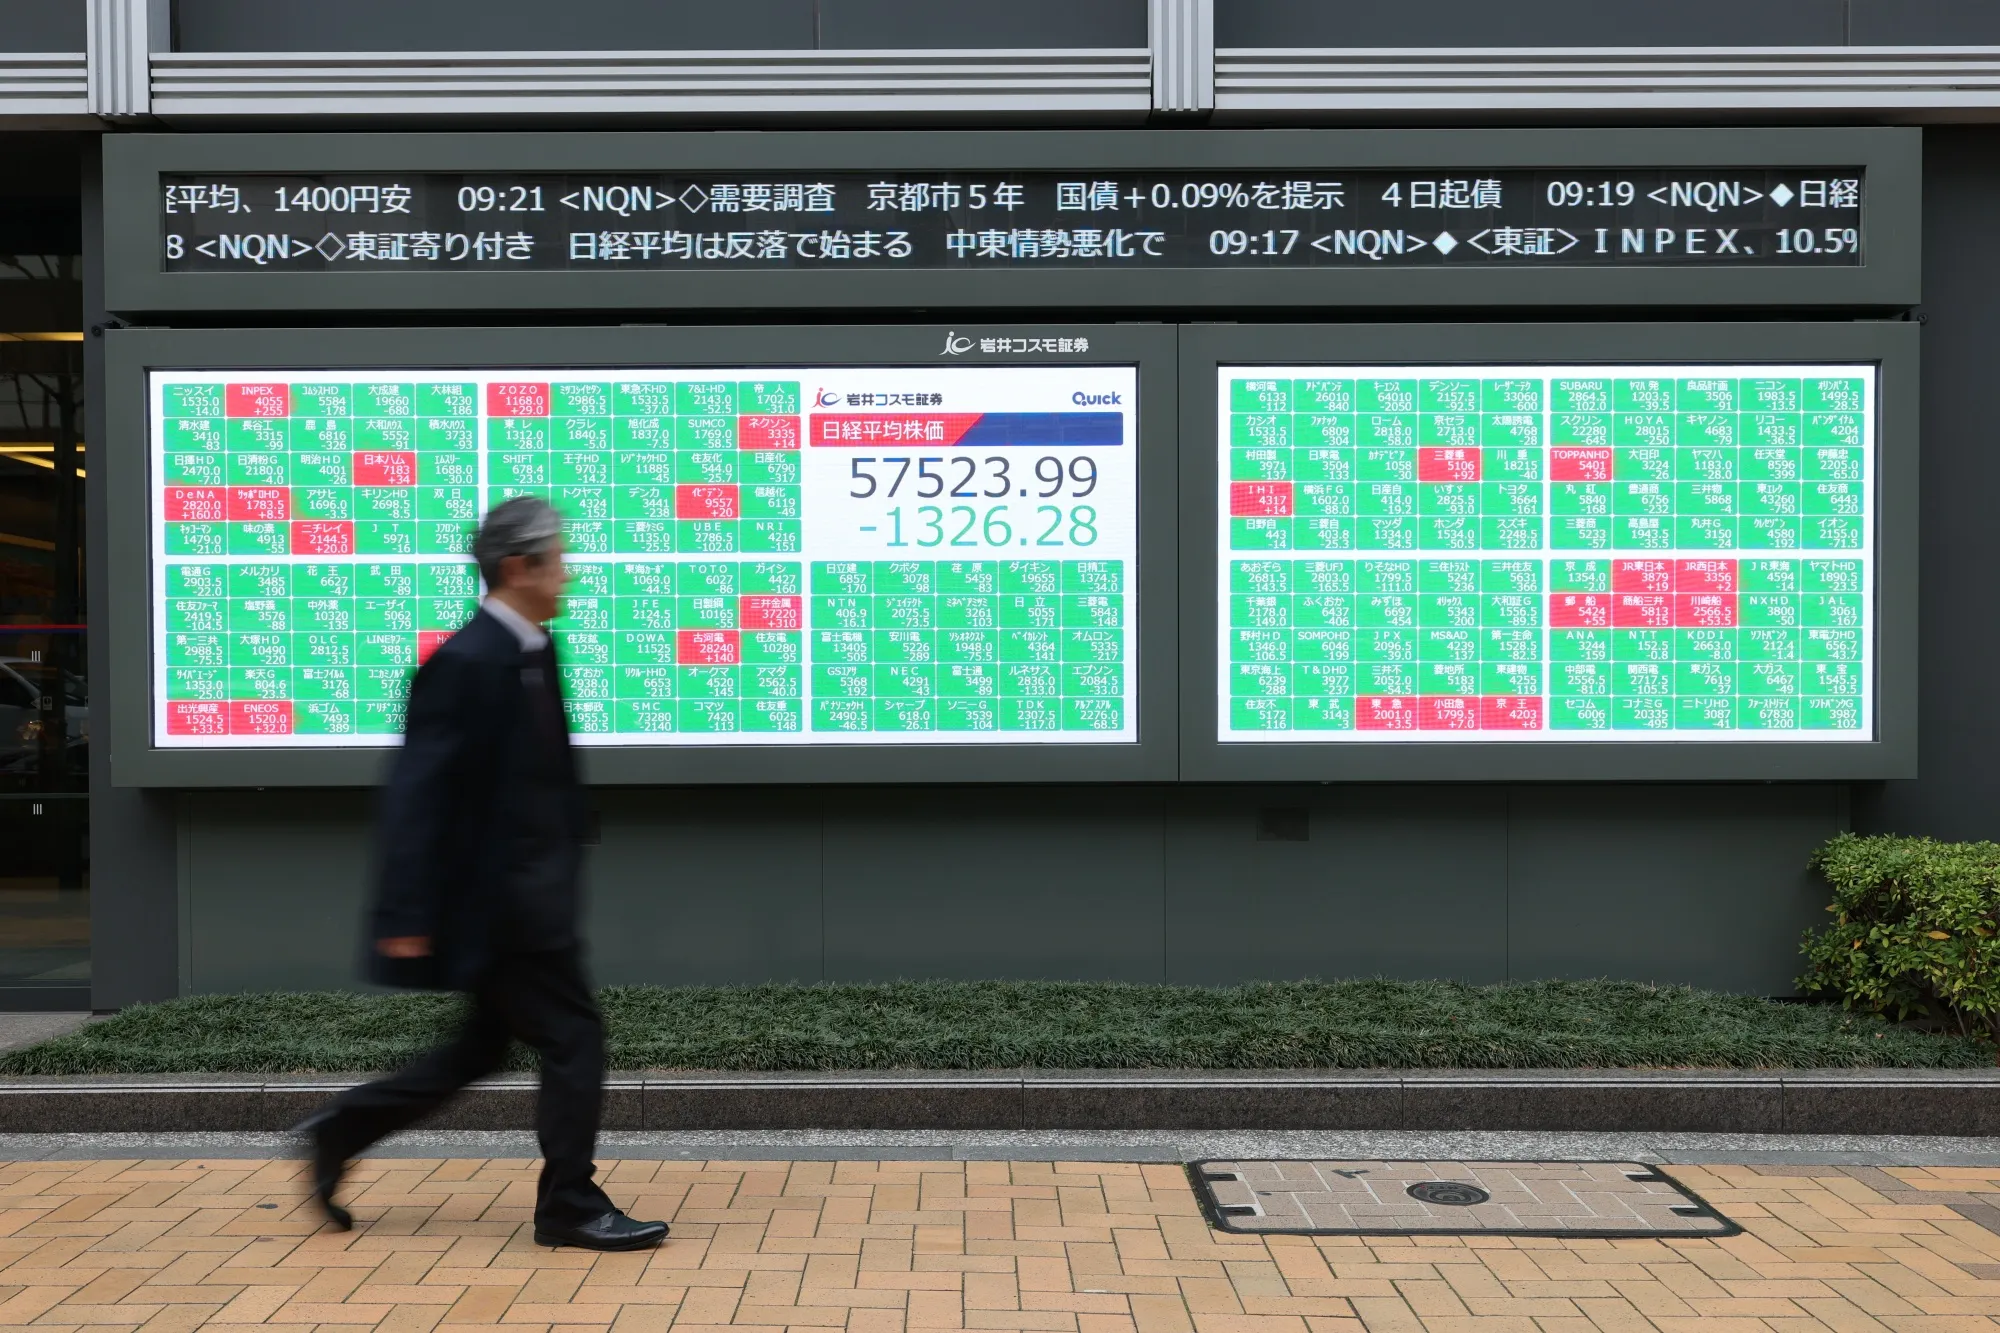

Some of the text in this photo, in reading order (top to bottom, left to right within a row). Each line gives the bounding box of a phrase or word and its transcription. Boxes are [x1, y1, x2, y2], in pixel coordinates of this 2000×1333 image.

[458, 187, 544, 211] 09:21
[867, 181, 1024, 211] 京都市5年
[1382, 179, 1501, 208] 4日起債
[1548, 182, 1634, 206] 09:19
[570, 230, 911, 260] 日経平均は反落で始まる
[947, 229, 1164, 257] 中東情勢悪化で
[1210, 230, 1298, 254] 09:17
[980, 336, 1089, 353] 岩井コスモ証券
[172, 386, 215, 396] ニッスイ
[241, 387, 274, 395] INPEX
[367, 385, 400, 396] 大成建
[430, 385, 463, 395] 大林組
[1428, 381, 1471, 391] デンソー
[1559, 382, 1603, 390] SUBARU
[1754, 381, 1787, 391] ニコン
[375, 396, 410, 405] 19660
[443, 396, 473, 405] 4230
[846, 393, 943, 406] 岩井コスモ証券
[1436, 392, 1475, 402] 2157.5
[1567, 391, 1607, 401] 2864.5
[1757, 391, 1796, 401] 1983.5
[181, 397, 220, 406] 1535.0
[254, 397, 284, 406] 4055
[1445, 402, 1476, 411] -92.5
[1568, 401, 1607, 411] -102.0
[1765, 401, 1796, 410] -13.5
[189, 406, 220, 416] -14.0
[253, 406, 283, 416] +255
[383, 406, 410, 415] -680
[446, 406, 473, 415] -186
[565, 419, 597, 429] クラレ
[627, 418, 660, 428] 旭化成
[687, 419, 726, 428] SUMCO
[748, 418, 791, 428] ネクソン
[1245, 415, 1277, 426] カシオ
[568, 430, 607, 440] 1840.5
[631, 429, 670, 439] 1837.0
[694, 429, 733, 439] 1769.0
[767, 429, 796, 438] 3335
[822, 420, 945, 441] 日経平均株価
[1248, 427, 1287, 436] 1533.5
[1704, 426, 1733, 435] 4683
[583, 440, 607, 449] -5.0
[646, 439, 670, 448] -7.5
[702, 439, 733, 448] -58.5
[772, 439, 796, 448] +14
[1257, 436, 1287, 446] -38.0
[1713, 435, 1733, 445] -79
[364, 454, 406, 464] 日本ハム
[690, 453, 723, 463] 住友化
[382, 465, 411, 474] 7183
[701, 463, 733, 473] 544.0
[767, 463, 796, 473] 6790
[387, 475, 411, 484] +34
[703, 473, 733, 483] -25.7
[769, 473, 796, 482] -317
[851, 456, 1097, 498] 57523.99
[306, 489, 338, 499] アサヒ
[360, 489, 409, 499] キリンHD
[1498, 484, 1528, 494] トヨタ
[371, 500, 411, 509] 2698.5
[1509, 495, 1538, 504] 3664
[309, 500, 348, 510] 1696.0
[1511, 505, 1538, 514] -161
[324, 510, 348, 519] -3.5
[387, 509, 411, 519] -8.5
[242, 523, 276, 533] 味の素
[860, 505, 1097, 547] -1326.28
[1496, 518, 1529, 529] スズキ
[1816, 518, 1849, 528] イオン
[301, 524, 343, 533] ニチレイ
[1819, 529, 1859, 538] 2155.0
[309, 534, 348, 544] 2144.5
[1498, 529, 1538, 539] 2248.5
[256, 535, 285, 544] 4913
[1501, 539, 1538, 549] -122.0
[1828, 538, 1858, 548] -71.5
[265, 544, 285, 554] -55
[314, 544, 349, 553] +20.0
[238, 566, 280, 576] メルカリ
[754, 564, 787, 574] ガイシ
[888, 563, 920, 573] クボタ
[1008, 562, 1051, 572] ダイキン
[257, 577, 286, 587] 3485
[767, 575, 796, 584] 4427
[902, 574, 930, 584] 3078
[1021, 574, 1056, 583] 19655
[1641, 572, 1669, 582] 3879
[259, 587, 286, 596] -190
[770, 584, 796, 594] -160
[909, 584, 930, 592] -98
[1029, 583, 1056, 592] -260
[1646, 582, 1669, 591] +19
[365, 600, 407, 610] エーザイ
[750, 598, 792, 608] 三井金属
[1370, 596, 1403, 606] みずほ
[383, 611, 412, 620] 5062
[761, 609, 797, 619] 37220
[1383, 607, 1413, 616] 6697
[385, 620, 412, 630] -179
[767, 619, 797, 628] +310
[1386, 617, 1413, 626] -454
[1071, 631, 1114, 641] オムロン
[1090, 641, 1119, 651] 5335
[1092, 651, 1119, 660] -217
[688, 667, 730, 677] オークマ
[1008, 666, 1051, 675] ルネサス
[1071, 665, 1114, 675] エプソン
[1752, 664, 1785, 674] 大ガス
[705, 678, 735, 688] 4520
[1016, 676, 1056, 686] 2836.0
[1079, 676, 1119, 686] 2084.5
[1766, 675, 1795, 684] 6467
[708, 688, 735, 696] -145
[1019, 686, 1056, 695] -133.0
[1088, 686, 1119, 695] -33.0
[1775, 684, 1795, 694] -49
[243, 704, 280, 712] ENEOS
[693, 702, 725, 711] コマツ
[1432, 699, 1465, 709] 小田急
[1564, 699, 1597, 708] セコム
[185, 715, 224, 724] 1524.5
[248, 714, 287, 723] 1520.0
[322, 714, 350, 724] 7493
[706, 712, 735, 722] 7420
[1437, 710, 1475, 719] 1799.5
[1577, 710, 1607, 719] 6006
[253, 724, 287, 733] +32.0
[324, 724, 350, 733] -389
[708, 722, 735, 731] -113
[1448, 719, 1475, 728] +7.0
[1586, 719, 1606, 728] -32
[190, 724, 225, 734] +33.5
